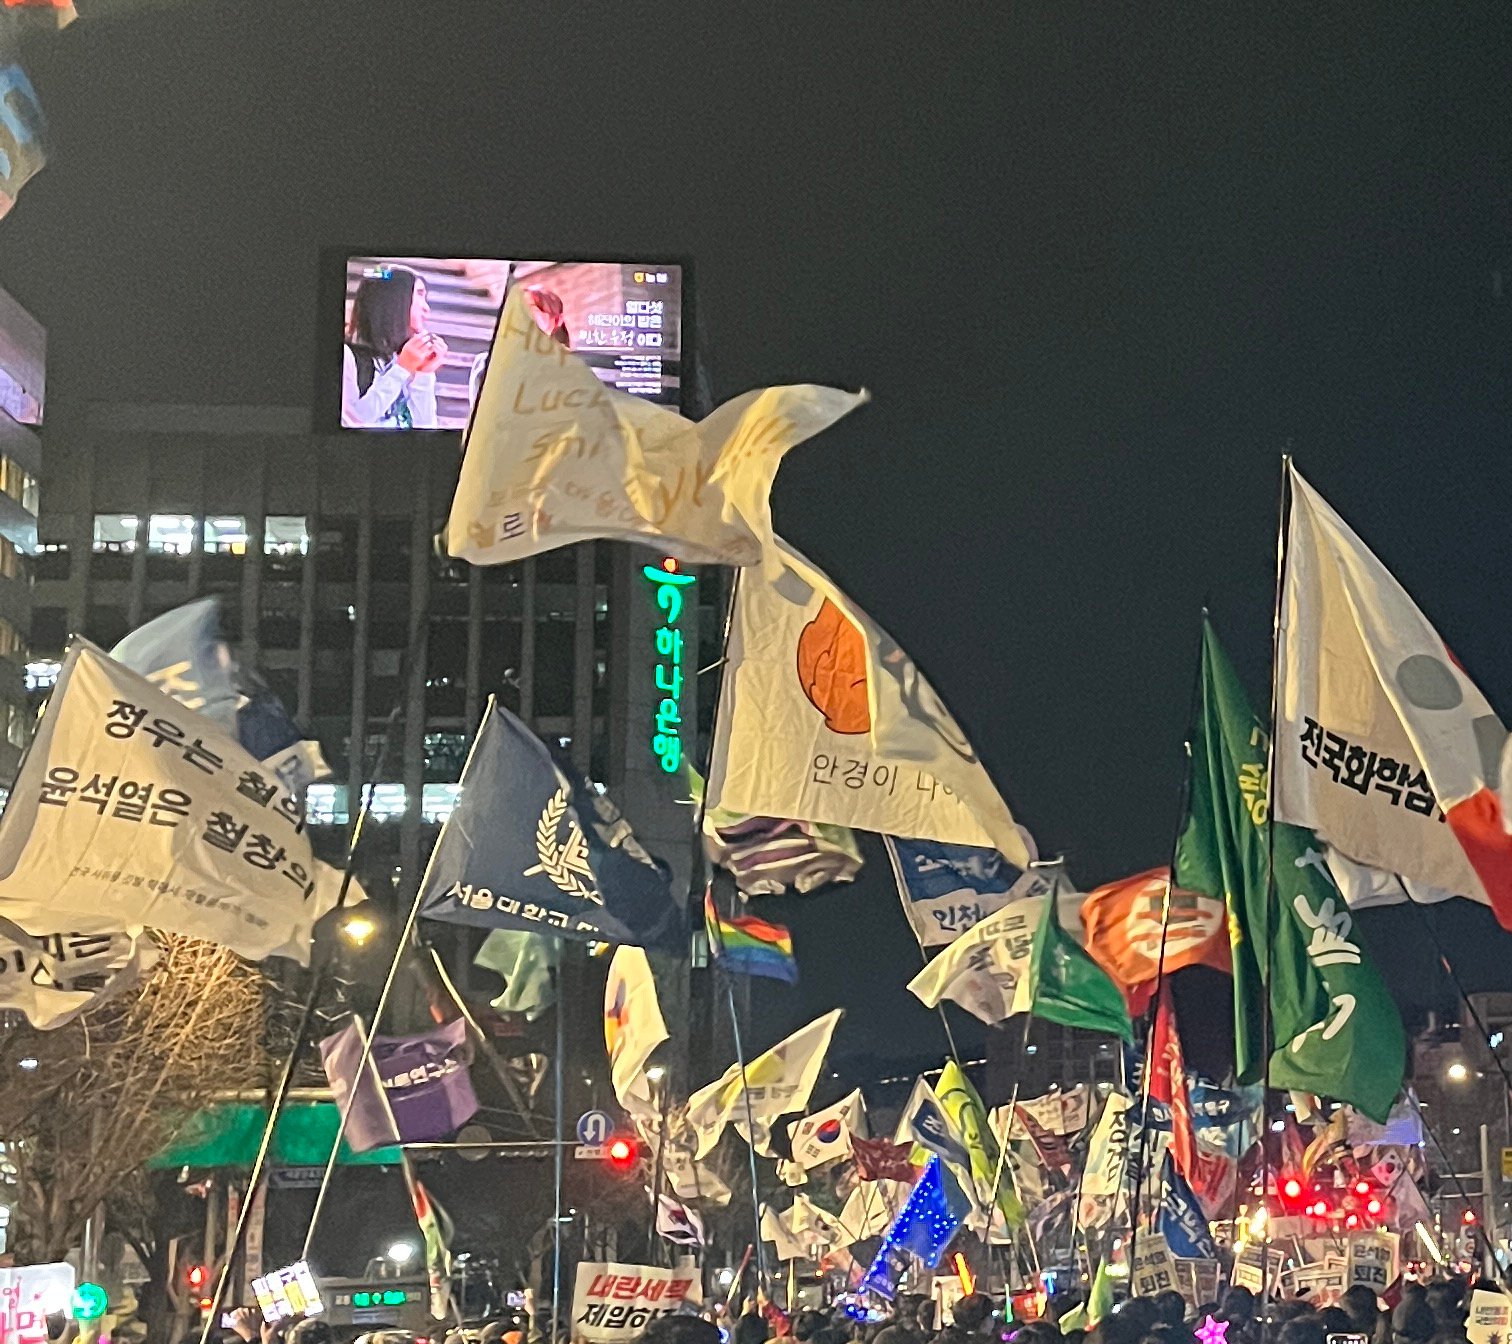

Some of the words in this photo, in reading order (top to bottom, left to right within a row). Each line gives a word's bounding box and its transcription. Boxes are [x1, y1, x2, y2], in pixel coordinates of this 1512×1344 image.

[653, 626, 685, 773] 하나은행
[105, 699, 224, 775] 정우는
[813, 754, 898, 797] 안경이
[40, 766, 193, 828] 윤석열은
[202, 811, 315, 900] 철창의
[446, 881, 570, 929] 서울대학교
[586, 1274, 694, 1302] 내란세력
[577, 1303, 677, 1329] 제압하
